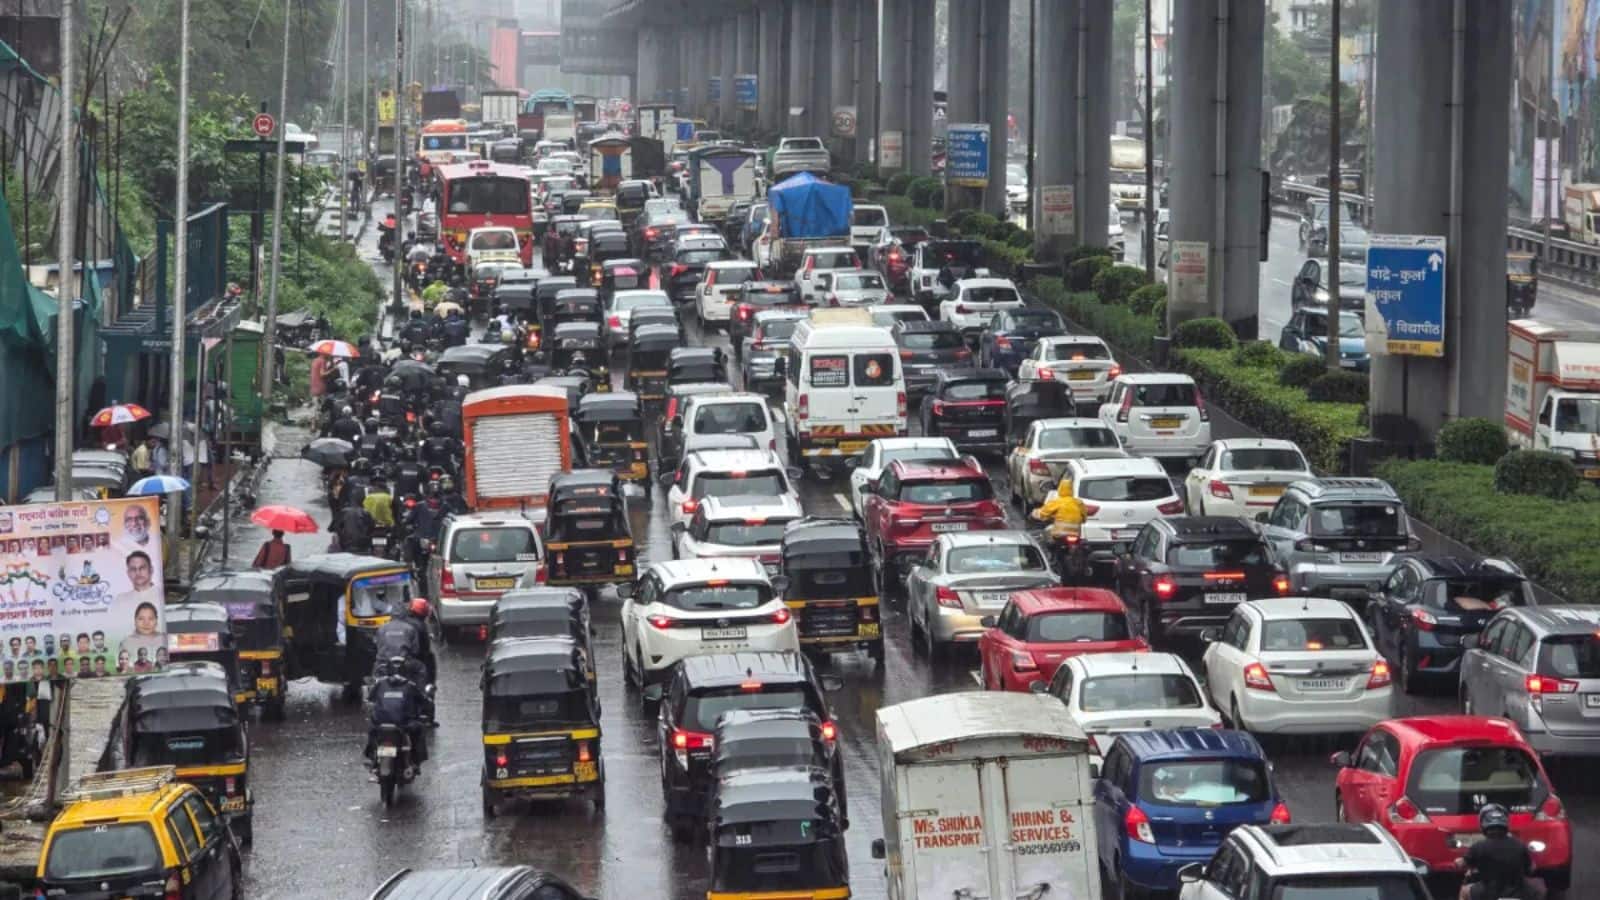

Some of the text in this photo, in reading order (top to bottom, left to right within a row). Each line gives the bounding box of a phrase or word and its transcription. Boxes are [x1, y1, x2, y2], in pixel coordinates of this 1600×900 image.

[939, 815, 982, 832] SHUKLA
[1012, 809, 1075, 826] HIRING &
[736, 834, 752, 845] 313
[914, 832, 980, 848] TRANSPORT
